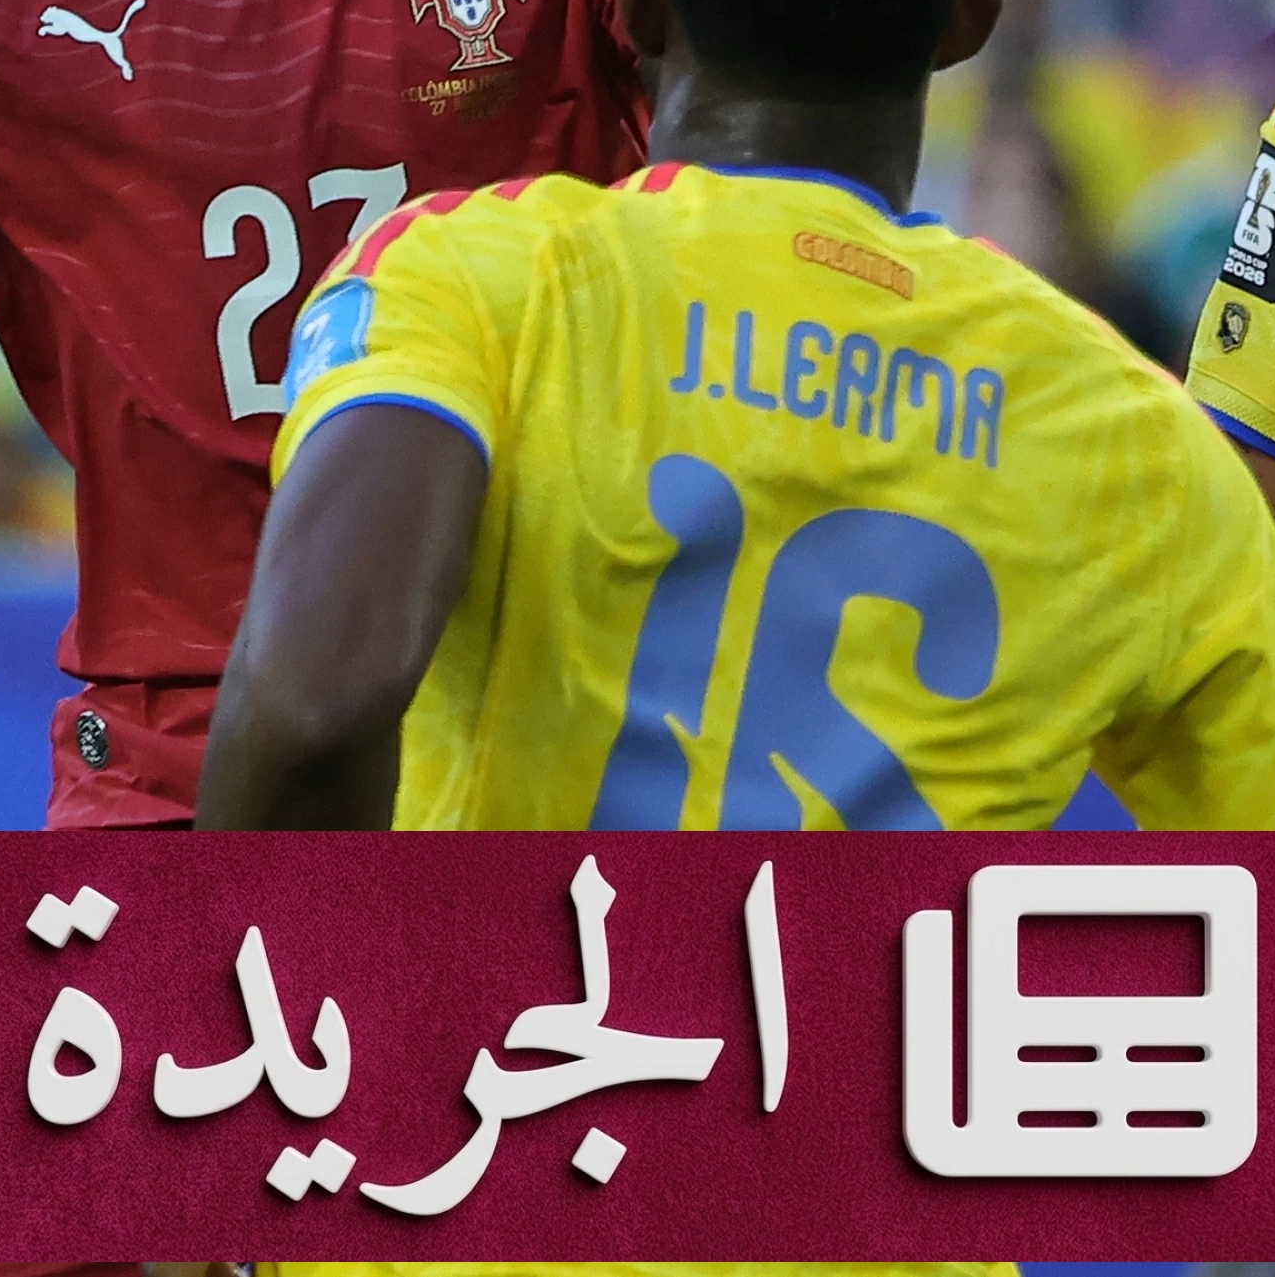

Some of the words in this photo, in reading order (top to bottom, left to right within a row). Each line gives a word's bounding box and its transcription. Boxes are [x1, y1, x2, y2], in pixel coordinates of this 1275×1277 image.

[1242, 228, 1260, 246] FIFA
[1228, 246, 1253, 264] WORLD
[1252, 257, 1268, 270] CUP
[1223, 257, 1266, 286] 2026
[670, 301, 1005, 468] J.LERMA
